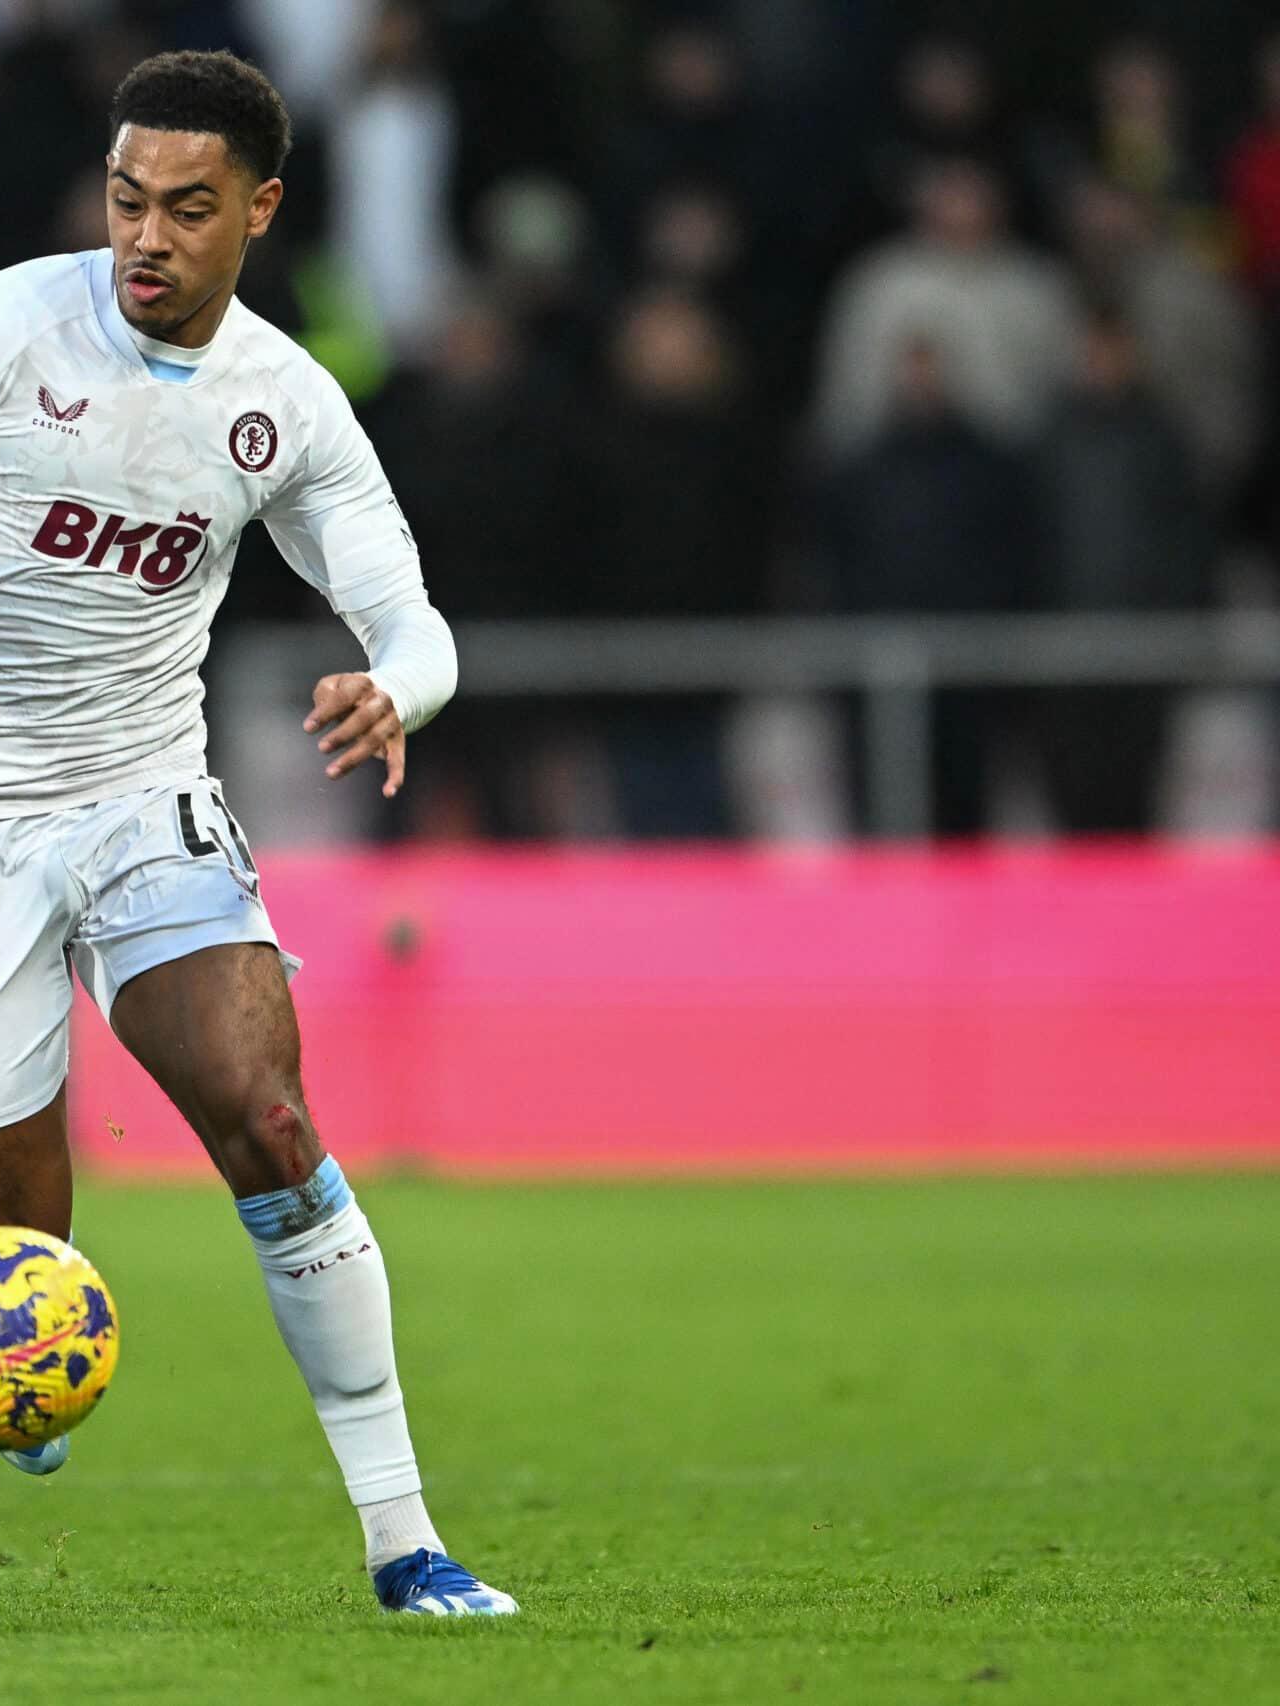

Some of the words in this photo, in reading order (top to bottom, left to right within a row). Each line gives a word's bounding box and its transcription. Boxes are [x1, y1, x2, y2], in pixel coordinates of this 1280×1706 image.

[32, 418, 80, 437] CASTORE
[236, 415, 258, 431] ASTON
[259, 415, 275, 436] VILLA
[30, 500, 203, 586] BK8
